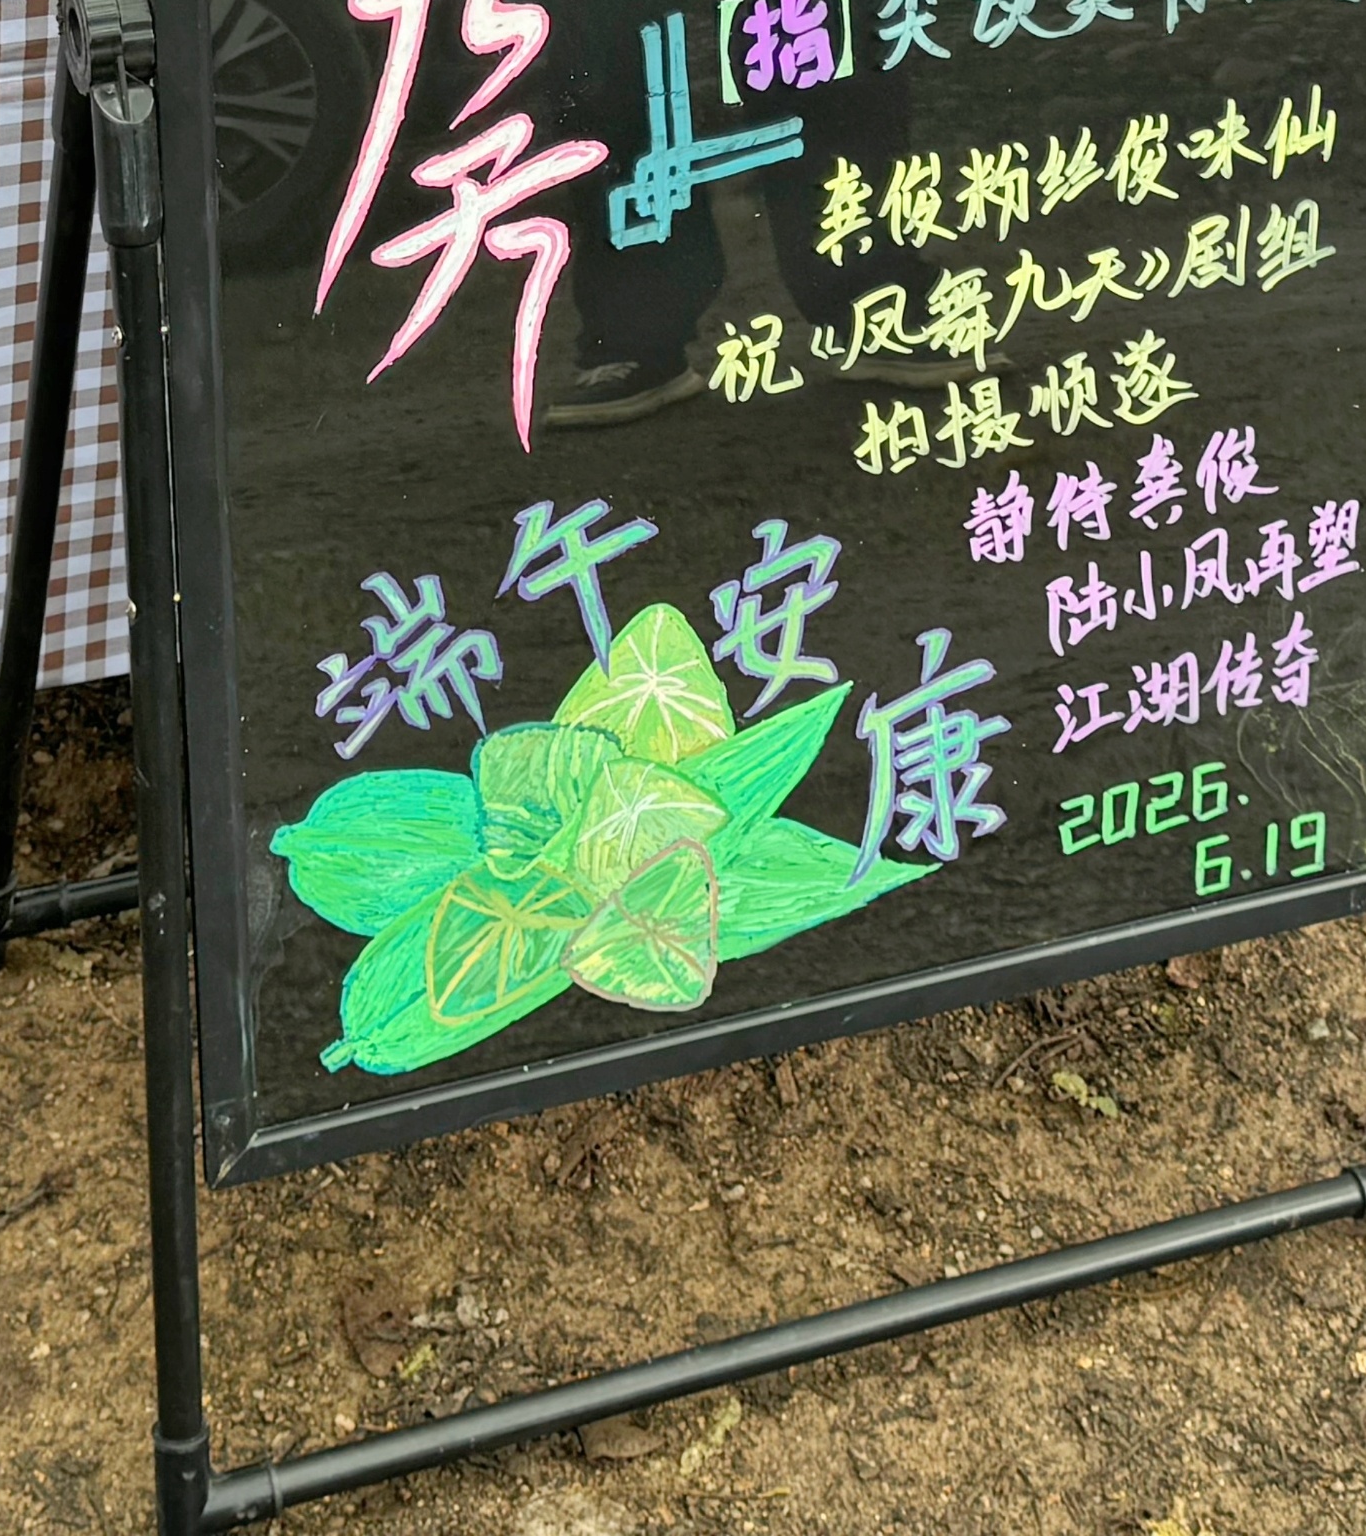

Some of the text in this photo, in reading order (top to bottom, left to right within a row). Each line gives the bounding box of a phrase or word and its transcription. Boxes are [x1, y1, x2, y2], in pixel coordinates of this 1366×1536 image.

[816, 83, 1338, 266] 龚俊粉丝俊味仙
[708, 199, 1337, 404] 祝《凤舞九天》剧组
[854, 329, 1199, 474] 拍摄顺遂
[962, 425, 1280, 564] 静待龚俊
[1045, 499, 1362, 656] 陆小凤再塑
[315, 498, 1013, 888] 端午安康
[1051, 611, 1321, 754] 江湖传奇
[1195, 810, 1327, 896] 6.19
